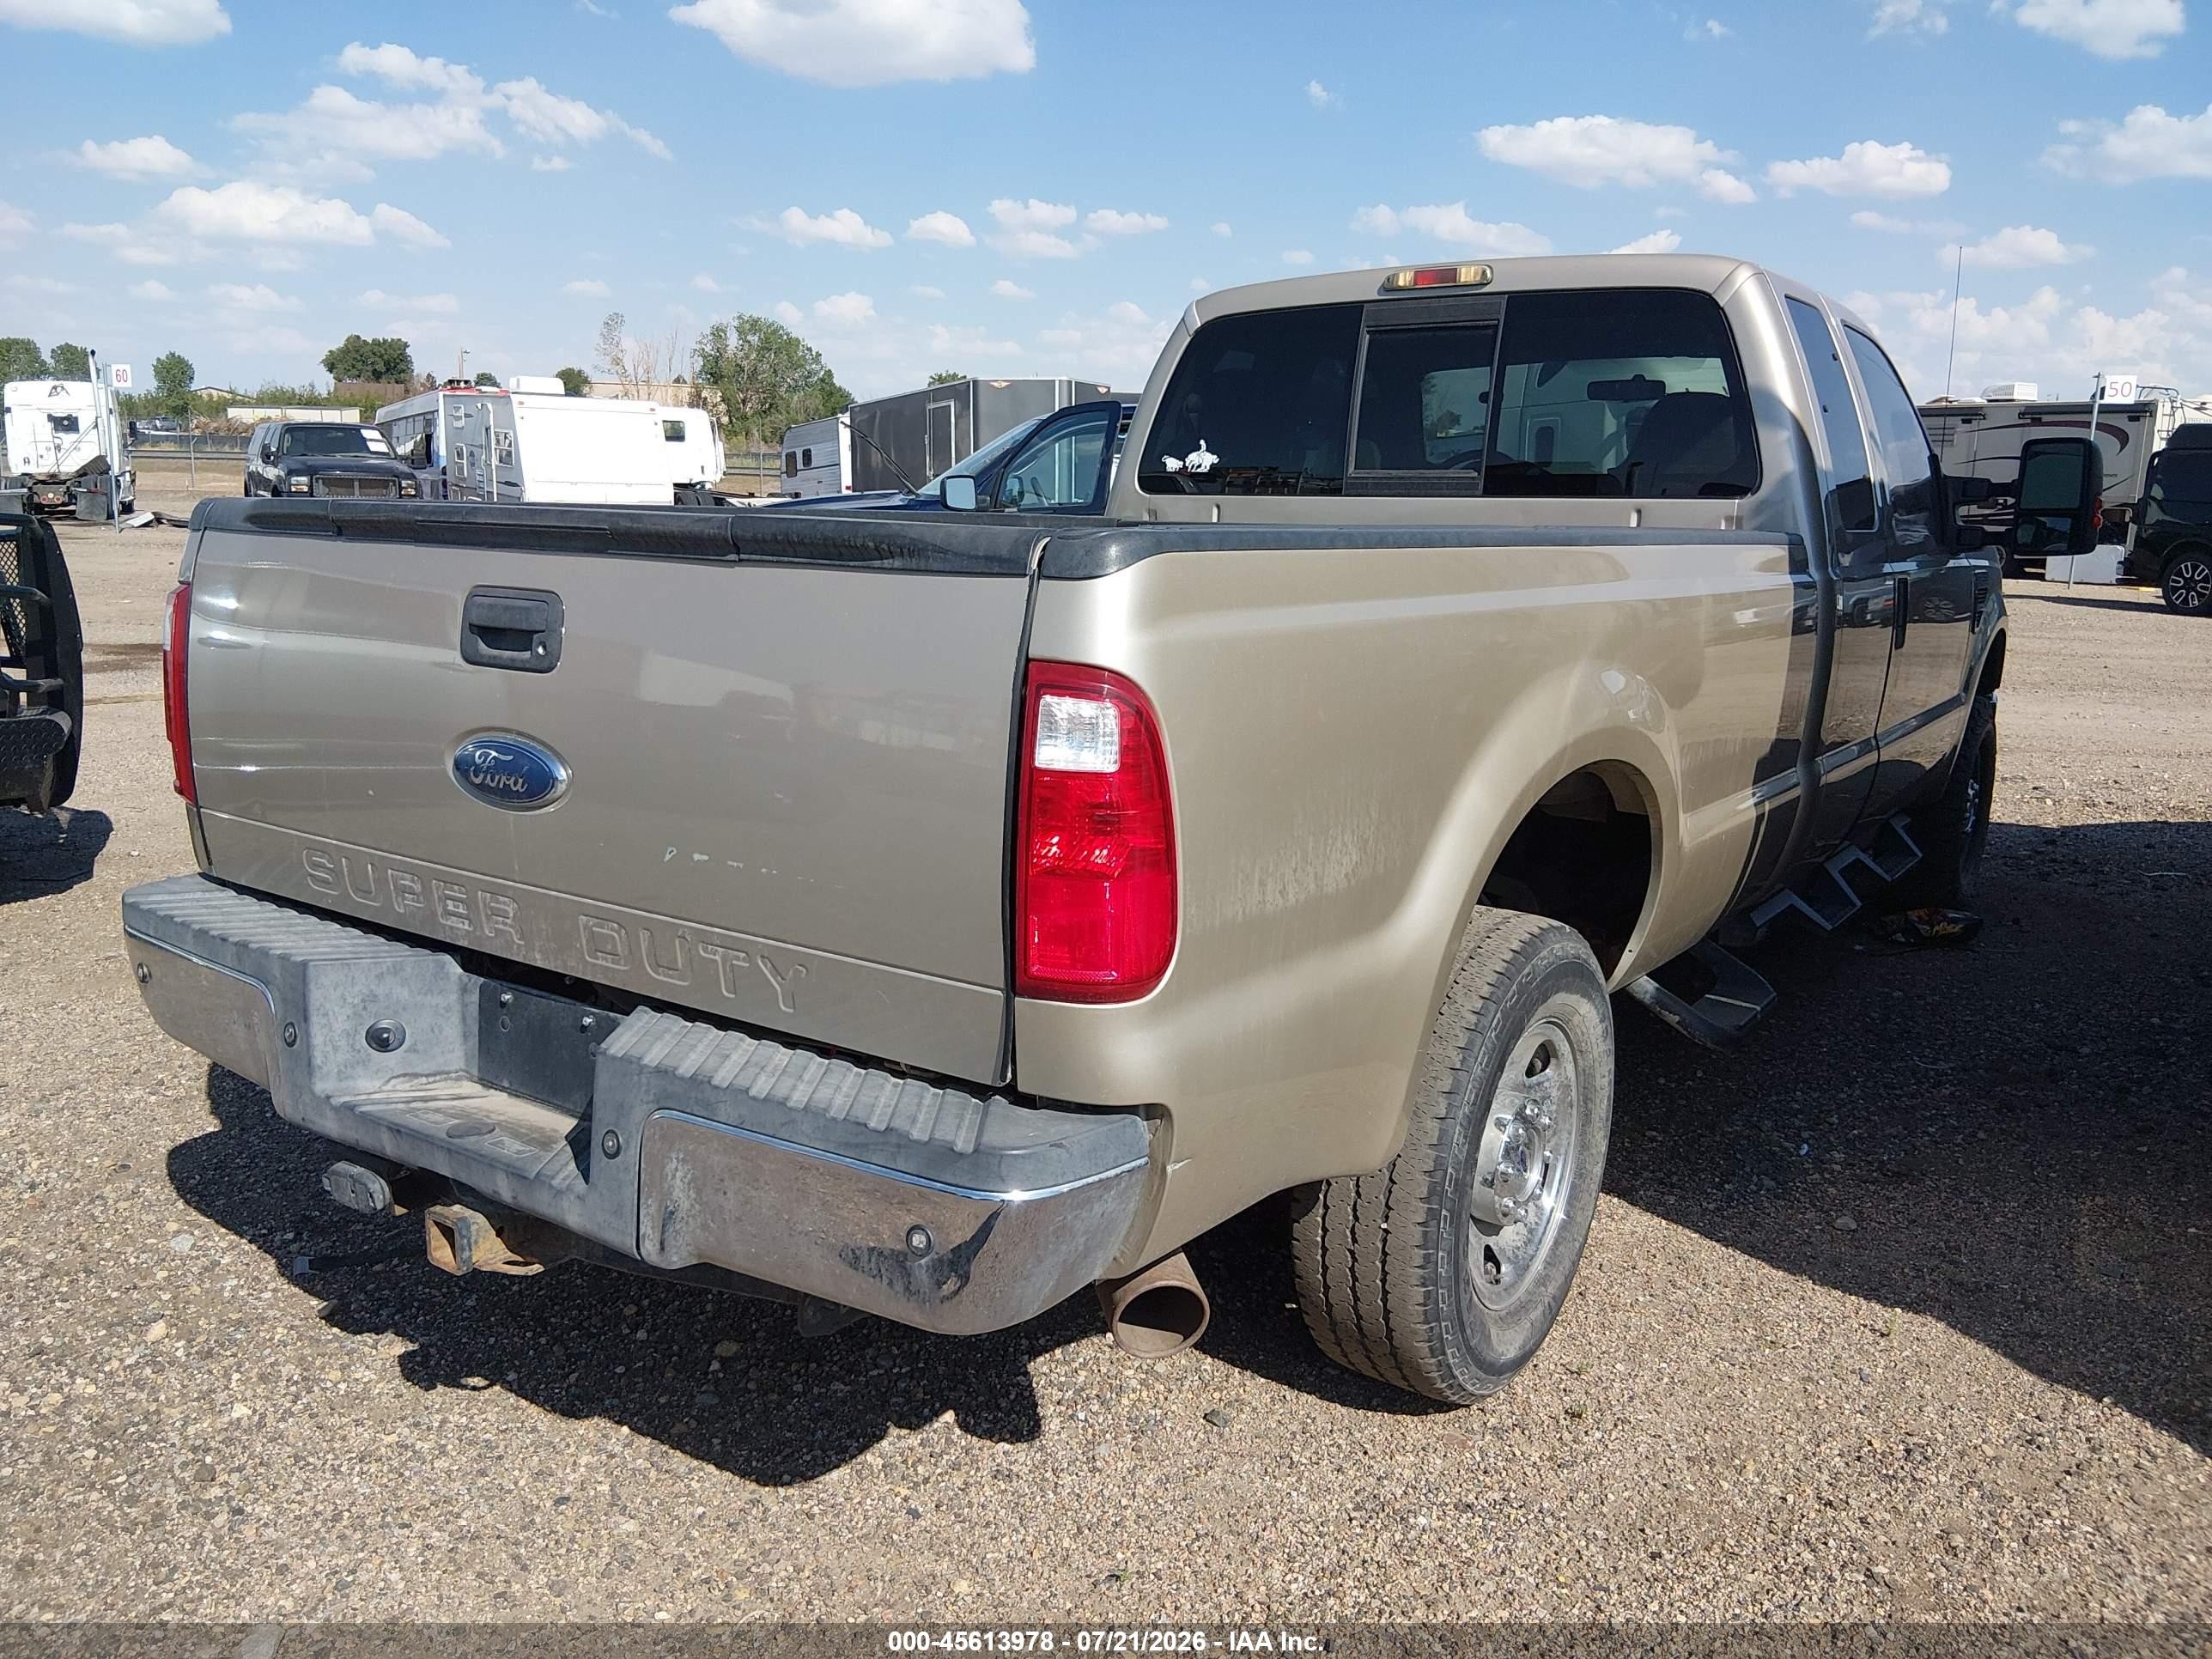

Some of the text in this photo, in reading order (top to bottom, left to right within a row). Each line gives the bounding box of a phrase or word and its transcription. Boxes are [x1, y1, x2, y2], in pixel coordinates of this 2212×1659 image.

[116, 368, 128, 383] 60
[2108, 381, 2132, 398] 50
[470, 749, 529, 793] Ford
[301, 847, 809, 1014] SUPER DUTY
